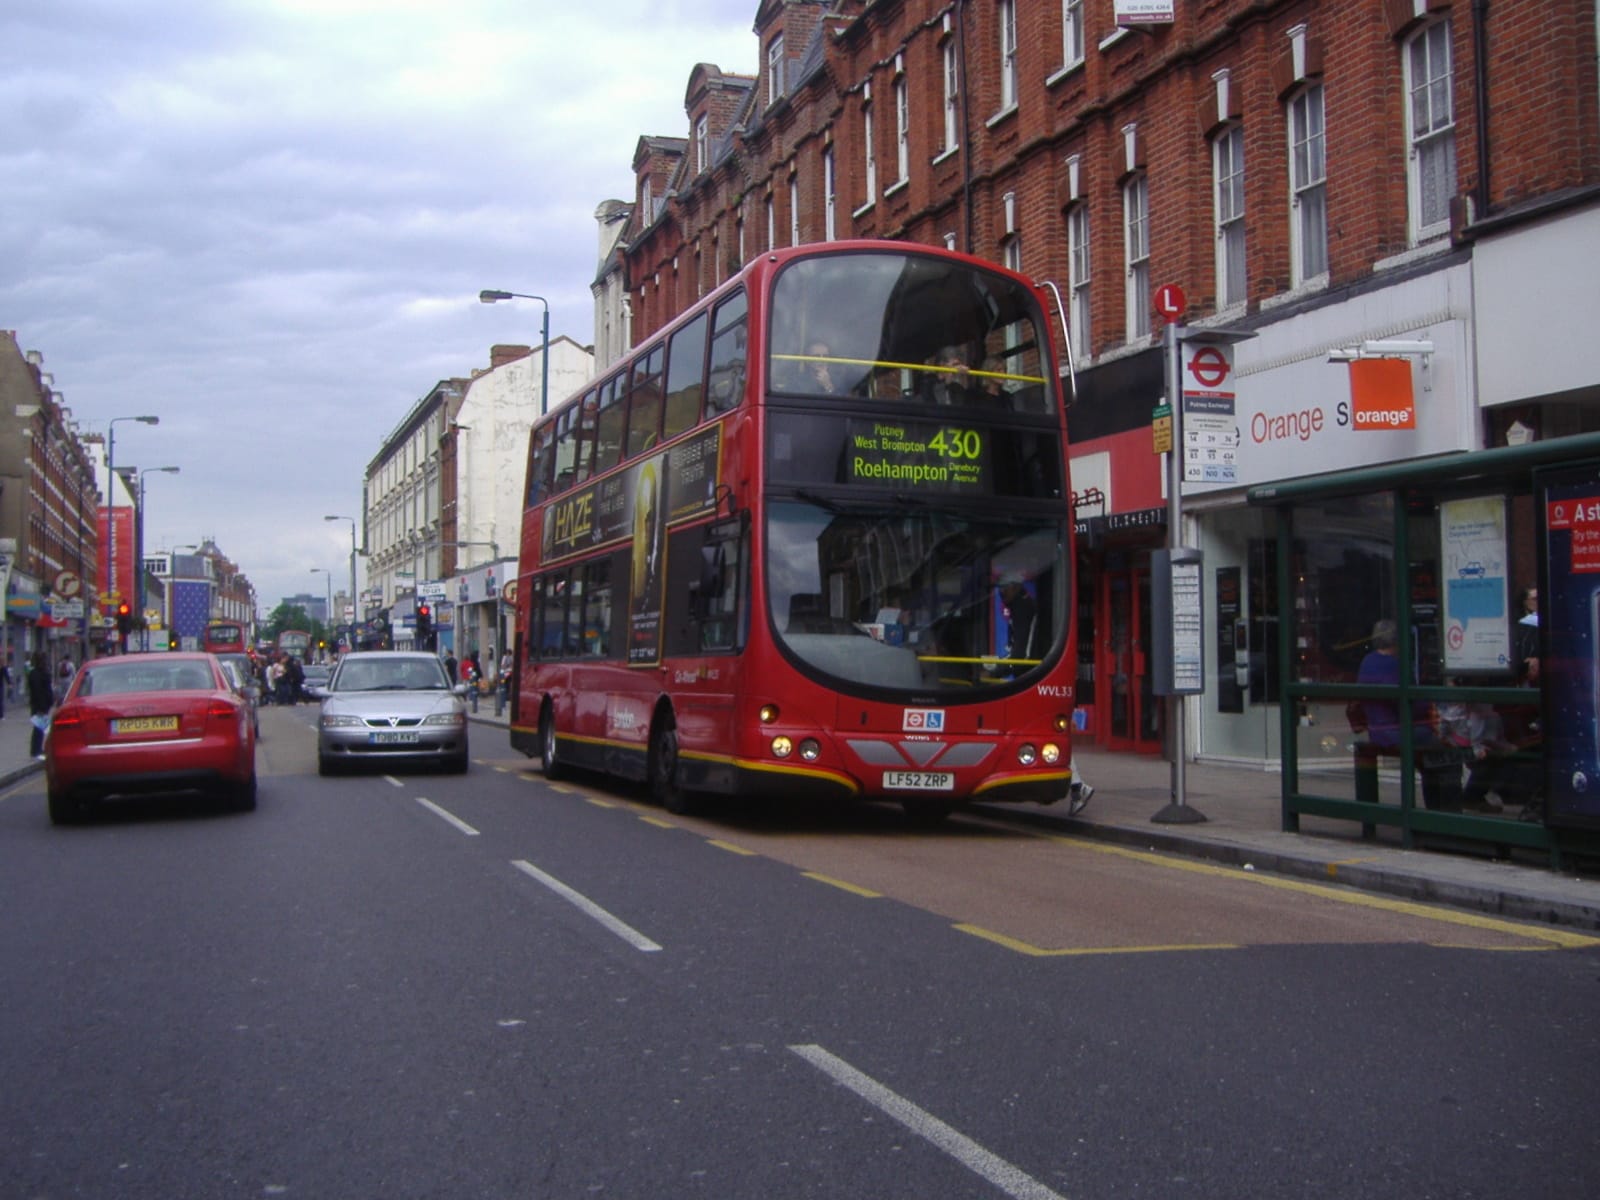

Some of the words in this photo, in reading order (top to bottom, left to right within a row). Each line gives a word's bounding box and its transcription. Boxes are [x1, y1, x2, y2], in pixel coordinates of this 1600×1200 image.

[1164, 288, 1178, 311] L
[874, 423, 905, 440] Putney
[1251, 406, 1324, 444] Orange
[854, 436, 878, 449] West
[881, 438, 926, 453] Brompton
[927, 428, 981, 459] 430
[853, 457, 948, 484] Roehampton
[948, 462, 980, 473] Danebury
[555, 492, 593, 546] HAZE
[1574, 503, 1585, 521] A
[1037, 685, 1073, 697] WVL33
[888, 773, 921, 787] LF52
[924, 774, 949, 787] ZRP
